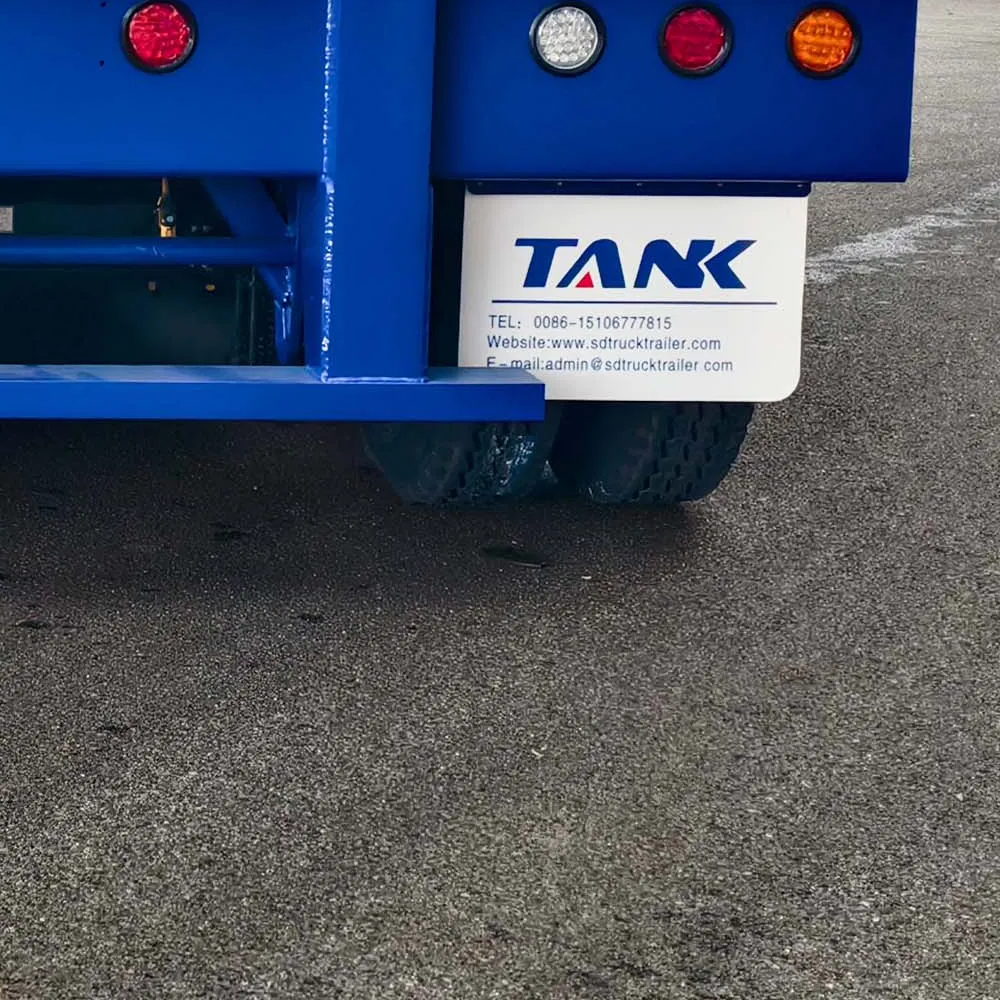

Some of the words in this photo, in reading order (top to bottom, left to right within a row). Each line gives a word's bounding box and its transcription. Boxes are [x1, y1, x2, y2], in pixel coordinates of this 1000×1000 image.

[514, 238, 758, 289] TANK
[488, 315, 522, 330] TEL:
[533, 315, 672, 330] 0086-15106777815
